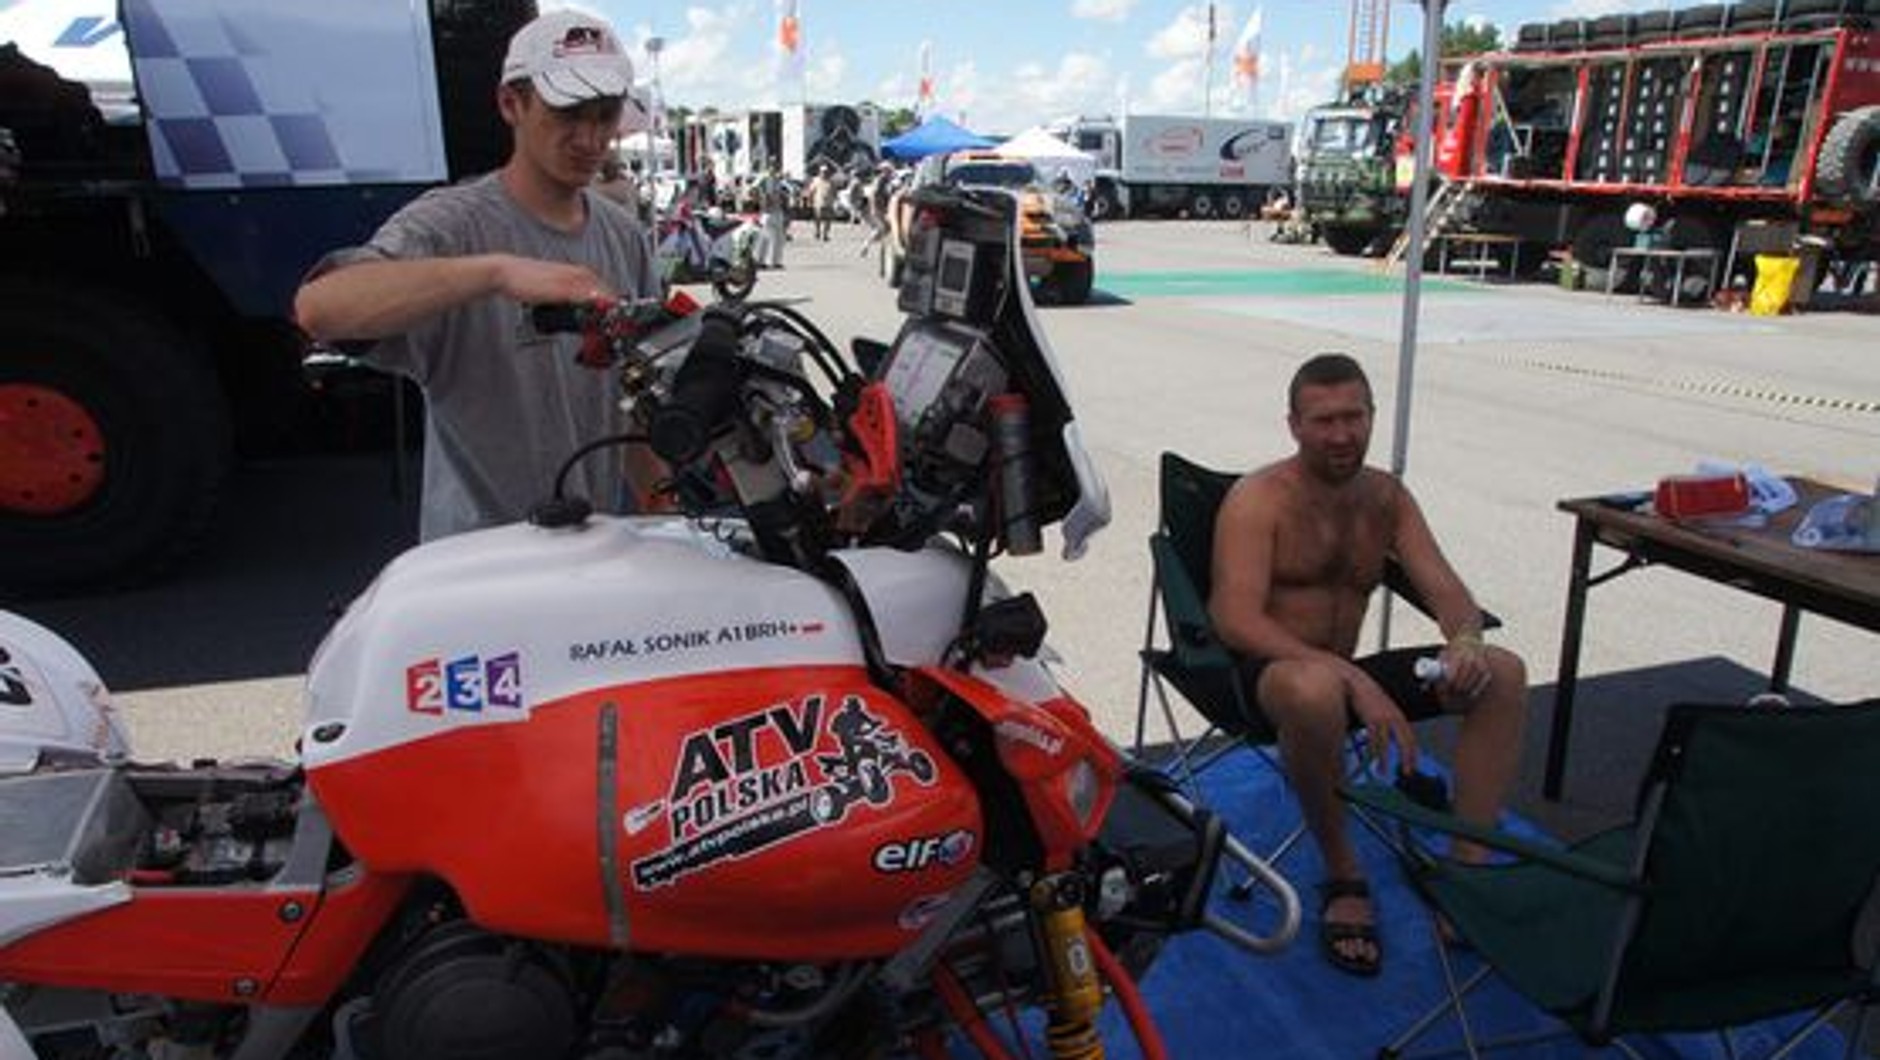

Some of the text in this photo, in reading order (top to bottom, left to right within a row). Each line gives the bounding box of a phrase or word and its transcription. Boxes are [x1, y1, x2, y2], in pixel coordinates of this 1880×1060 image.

[569, 639, 638, 661] RAFAŁ
[644, 630, 710, 653] SONIK
[670, 696, 823, 801] ATV
[672, 760, 806, 839] POLSKA
